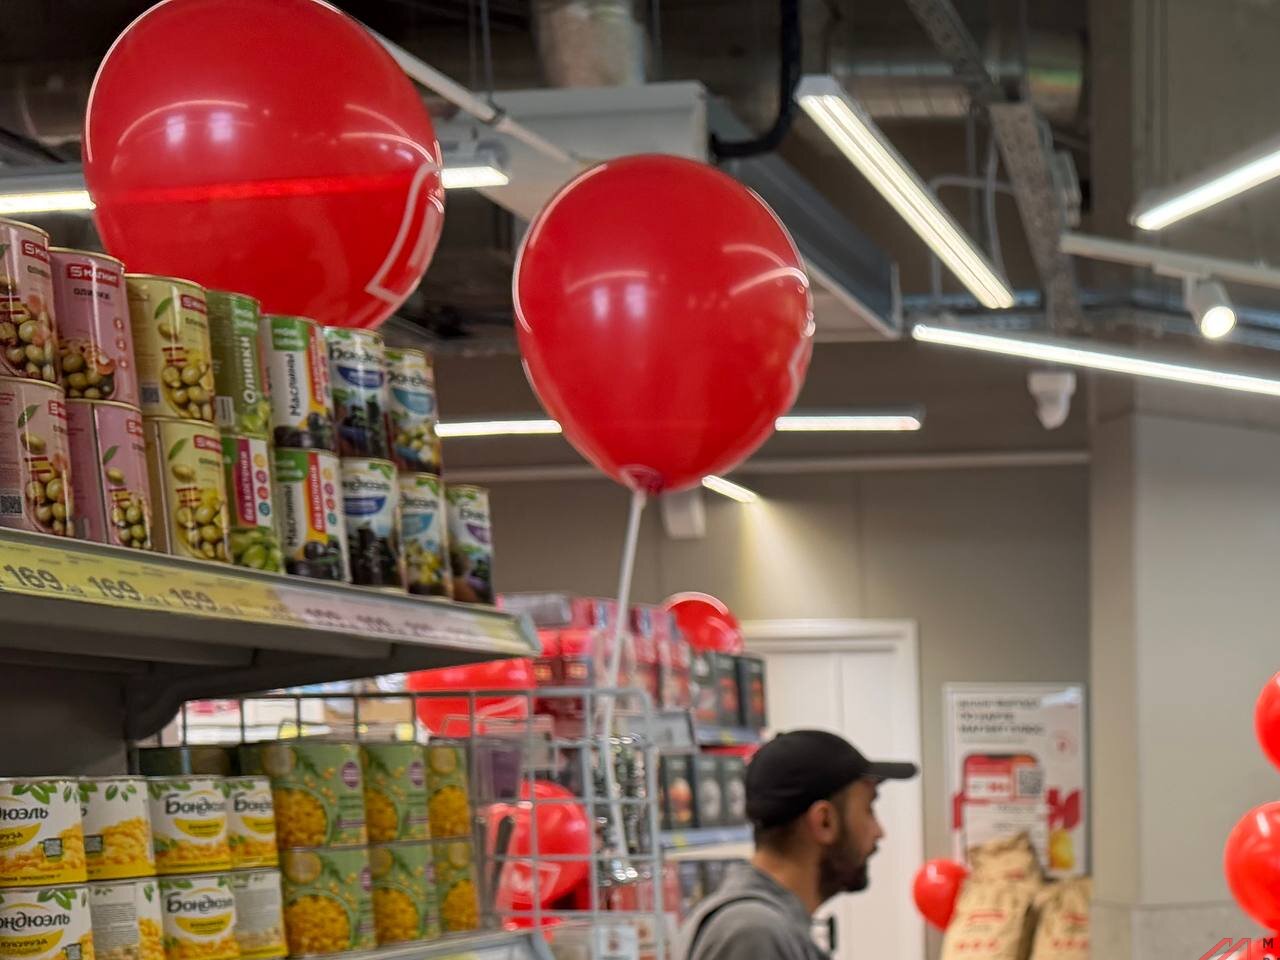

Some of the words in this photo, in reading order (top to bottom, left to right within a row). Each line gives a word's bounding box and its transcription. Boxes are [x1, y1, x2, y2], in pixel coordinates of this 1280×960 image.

[239, 336, 257, 404] Оливки
[285, 352, 302, 417] Маслины
[4, 563, 64, 592] 169
[89, 575, 142, 602] 169
